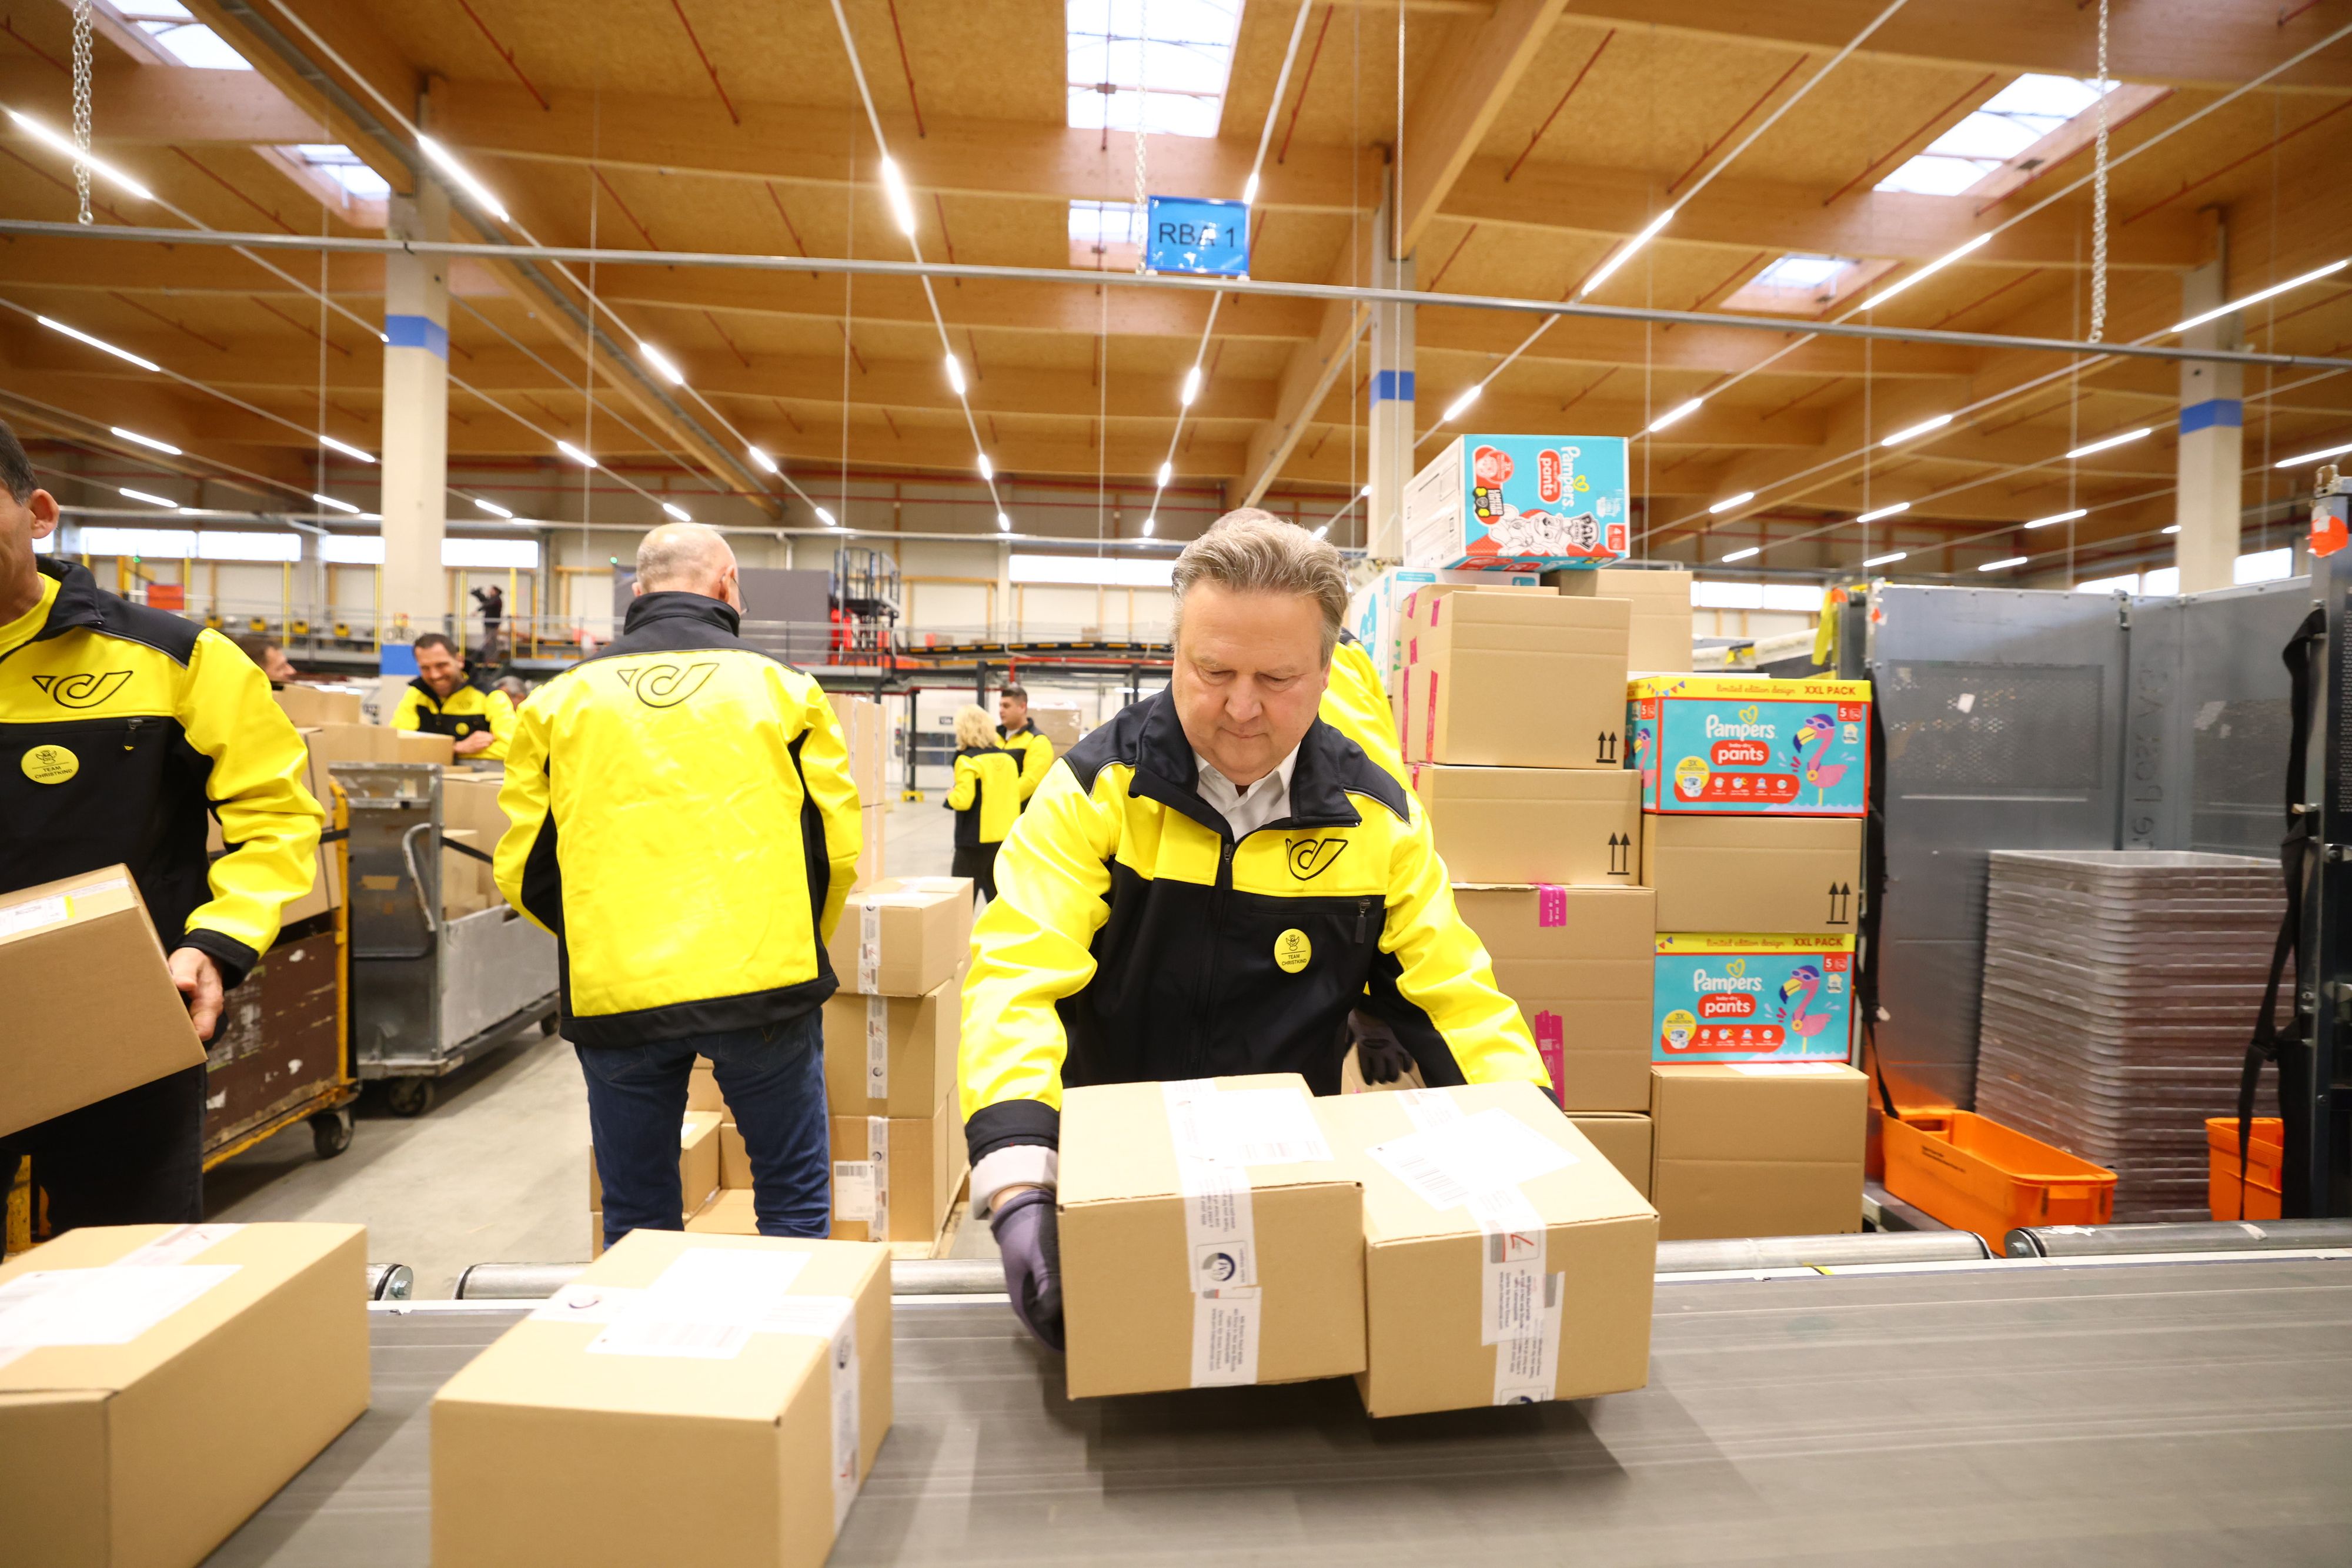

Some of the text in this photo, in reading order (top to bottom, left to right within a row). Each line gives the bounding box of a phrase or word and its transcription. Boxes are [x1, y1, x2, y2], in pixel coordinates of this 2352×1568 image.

[1226, 227, 1234, 247] 1
[1540, 457, 1553, 496] pants
[1561, 446, 1581, 507] Pampers
[1581, 515, 1593, 550] PAW
[1805, 686, 1824, 694] XXL
[1827, 687, 1856, 695] PACK
[1839, 707, 1847, 717] 5
[1706, 714, 1776, 741] Pampers
[1718, 748, 1765, 764] pants
[35, 768, 73, 779] CHRISTKIND
[1793, 938, 1812, 947] XXL
[1815, 938, 1843, 947] PACK
[1825, 958, 1832, 968] 5
[1693, 969, 1763, 994] Pampers
[1705, 1000, 1751, 1017] pants
